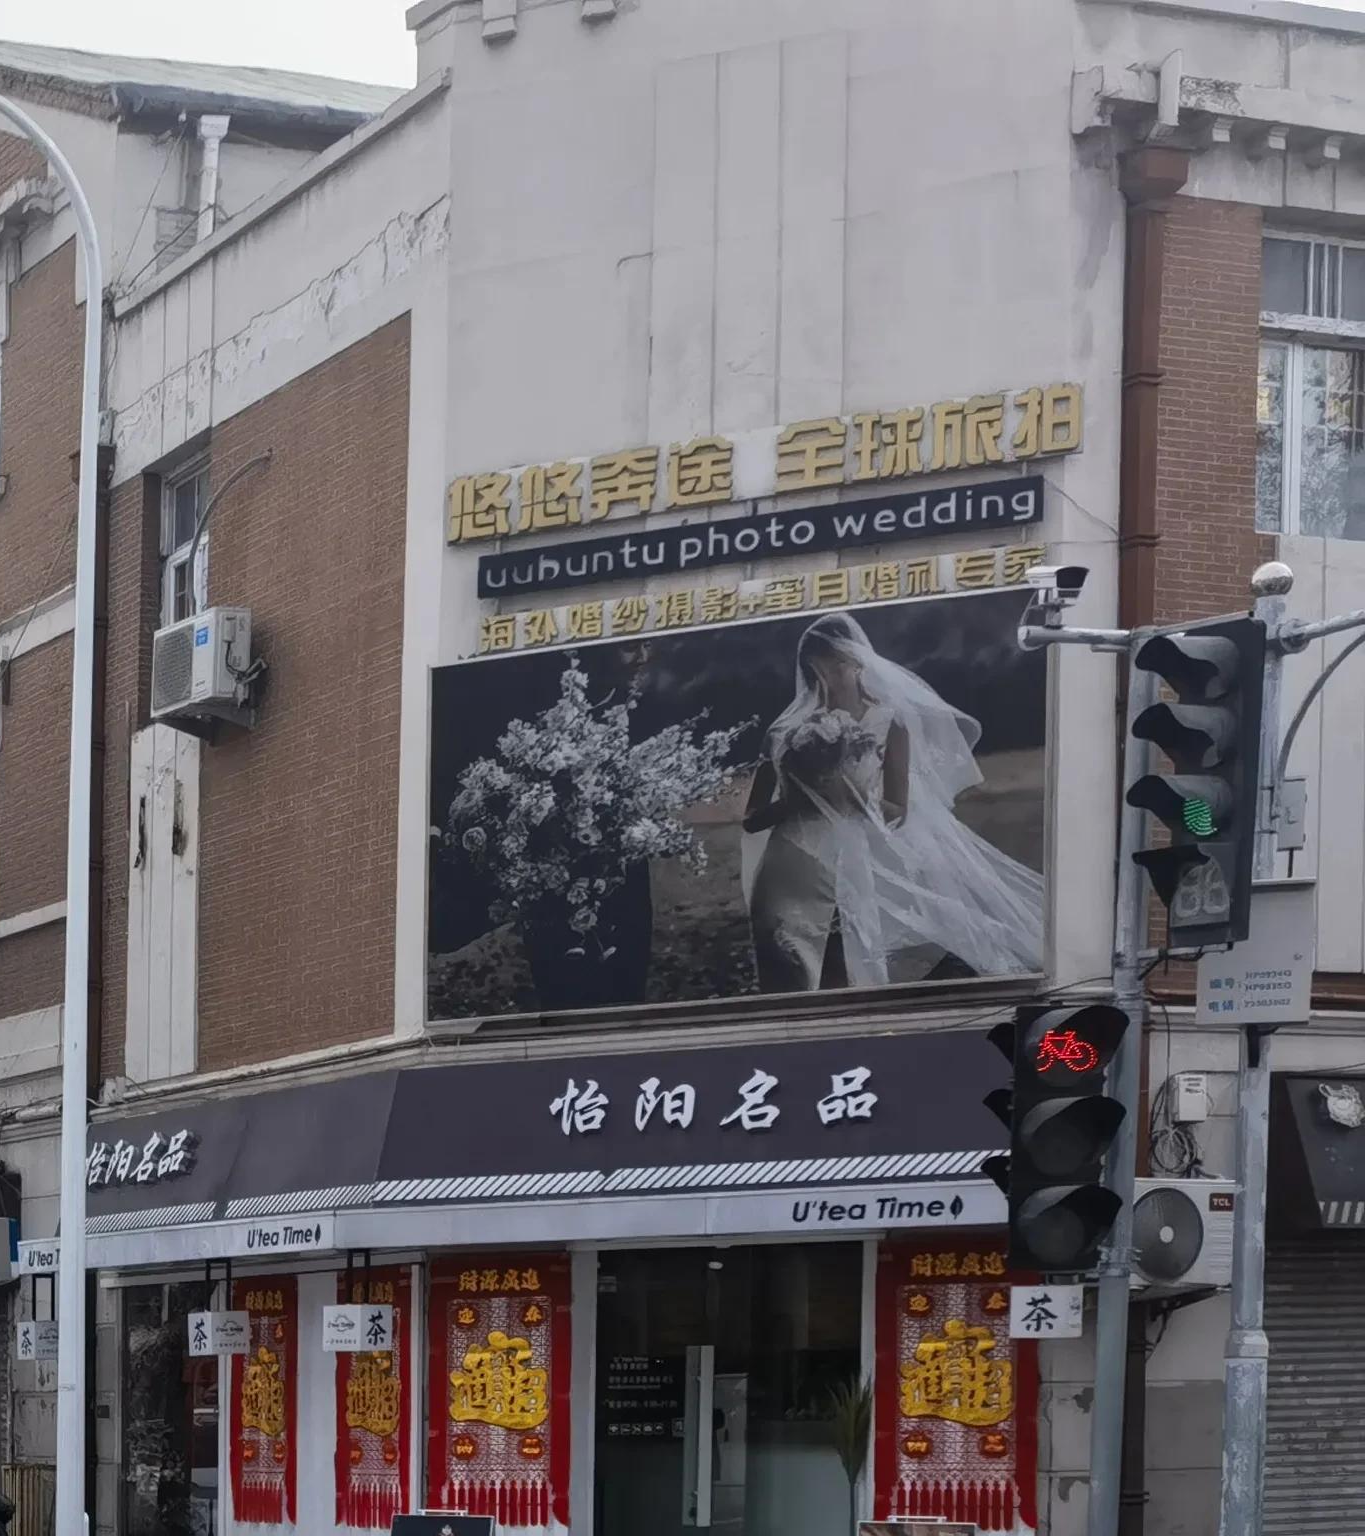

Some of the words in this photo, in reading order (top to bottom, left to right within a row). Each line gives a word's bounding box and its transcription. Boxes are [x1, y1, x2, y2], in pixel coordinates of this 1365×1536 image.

[449, 436, 735, 544] 悠悠奔途
[774, 384, 1082, 493] 全球旅拍
[680, 520, 816, 568] photo
[833, 489, 1036, 538] wedding
[548, 1066, 879, 1136] 怡阳名品
[85, 1129, 189, 1187] 怡阳名品
[875, 1196, 946, 1220] Time
[1212, 1198, 1231, 1207] TCL
[282, 1227, 314, 1246] Time
[366, 1309, 388, 1347] 茶
[1021, 1293, 1058, 1333] 茶
[21, 1327, 33, 1356] 茶
[193, 1318, 208, 1351] 茶
